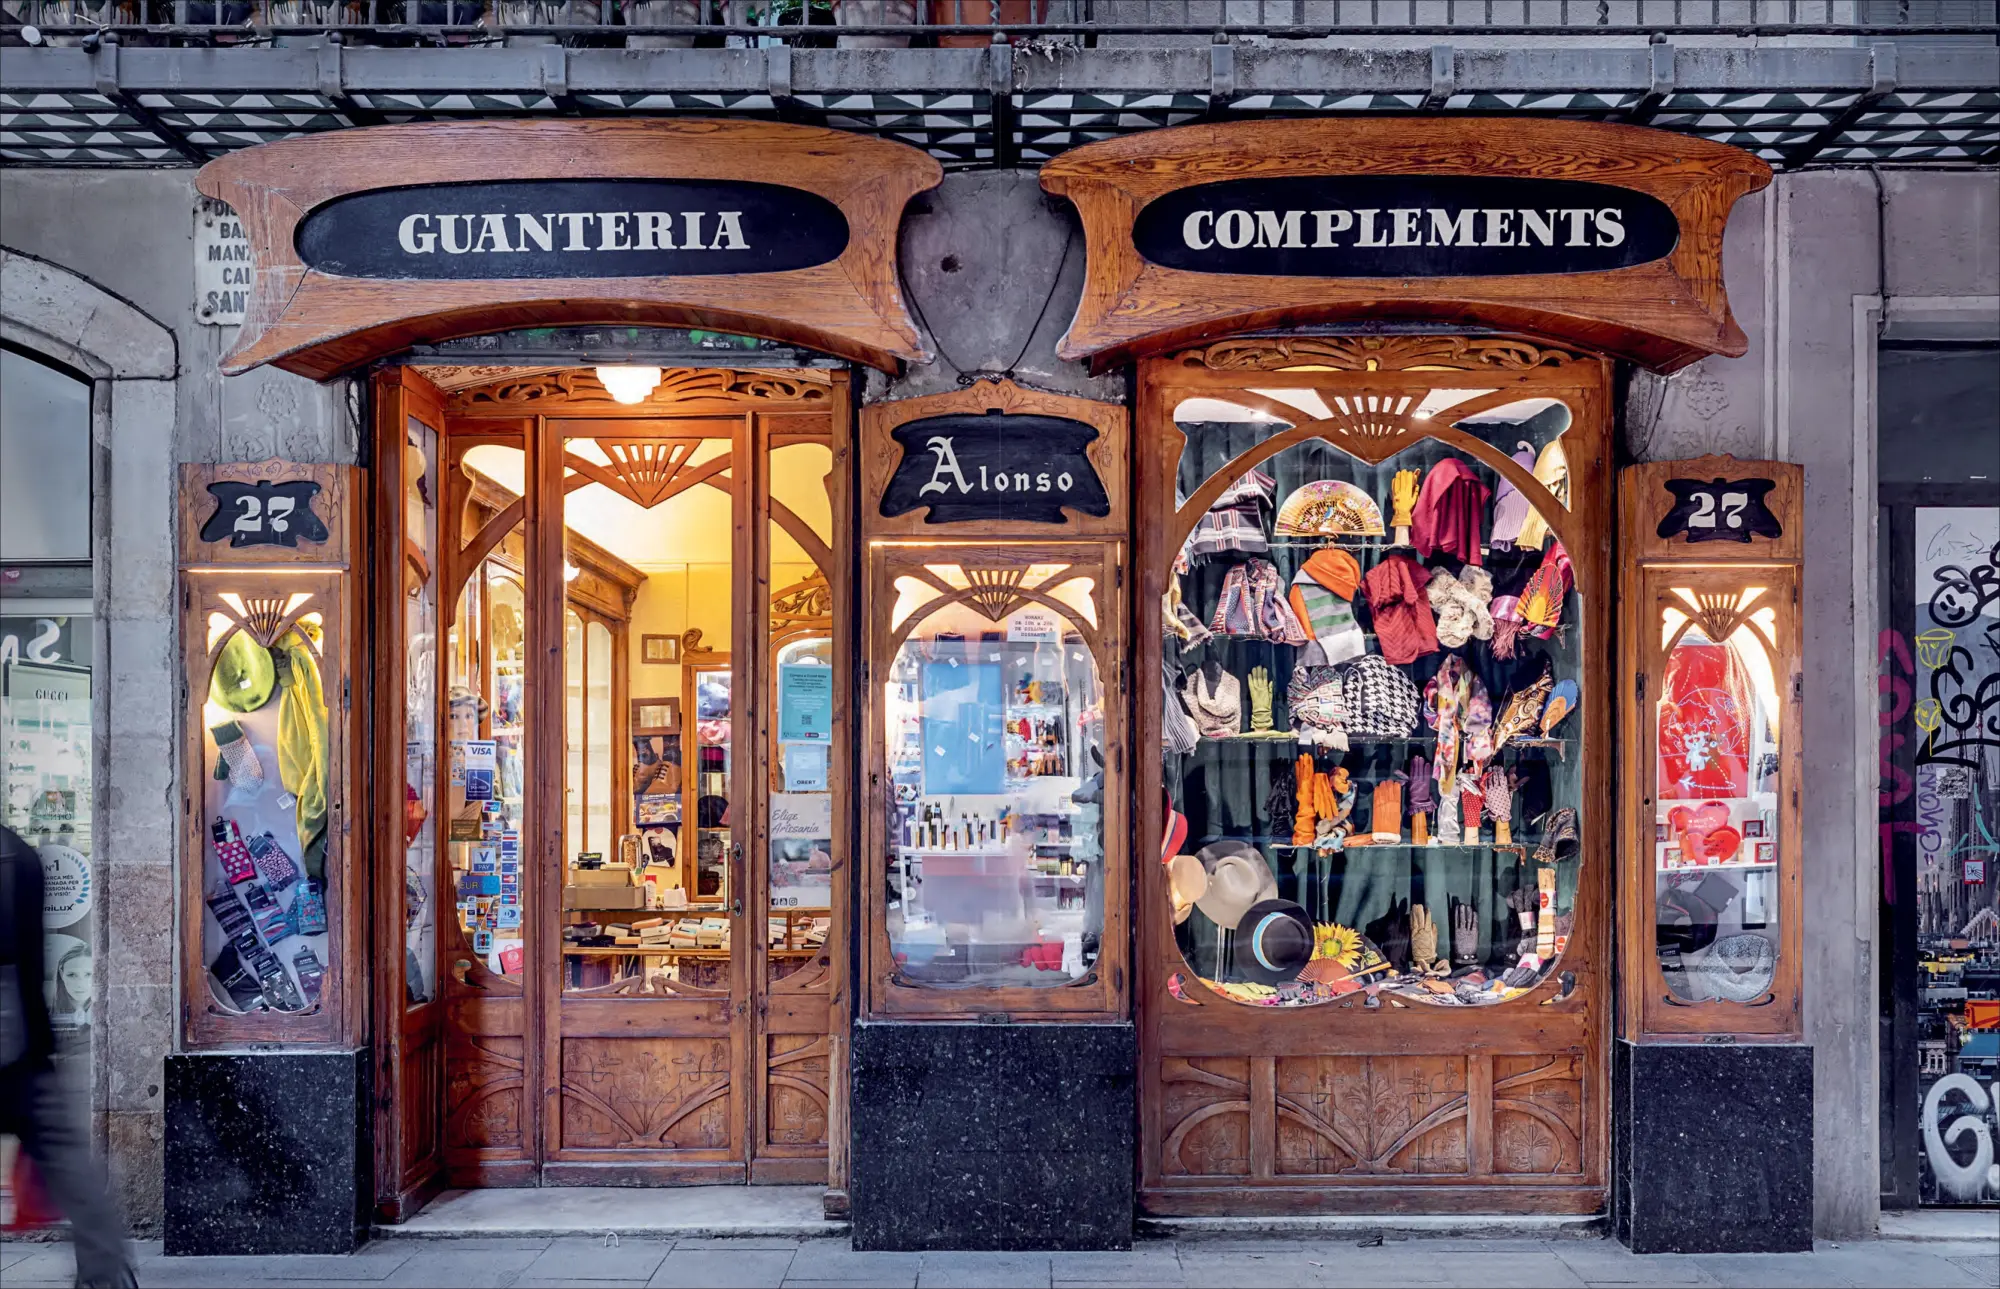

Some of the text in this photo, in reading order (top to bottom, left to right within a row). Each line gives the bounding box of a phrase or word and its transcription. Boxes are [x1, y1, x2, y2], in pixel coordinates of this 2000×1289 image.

[398, 211, 751, 254] GUANTERIA
[1182, 207, 1626, 250] COMPLEMENTS
[207, 291, 250, 313] SAN
[919, 436, 1074, 498] Alonso
[233, 495, 296, 533] 27
[1688, 492, 1748, 528] 27
[35, 688, 68, 701] GUCCI
[471, 747, 492, 755] VISA
[771, 809, 799, 824] Elige
[771, 822, 820, 834] Artesanía
